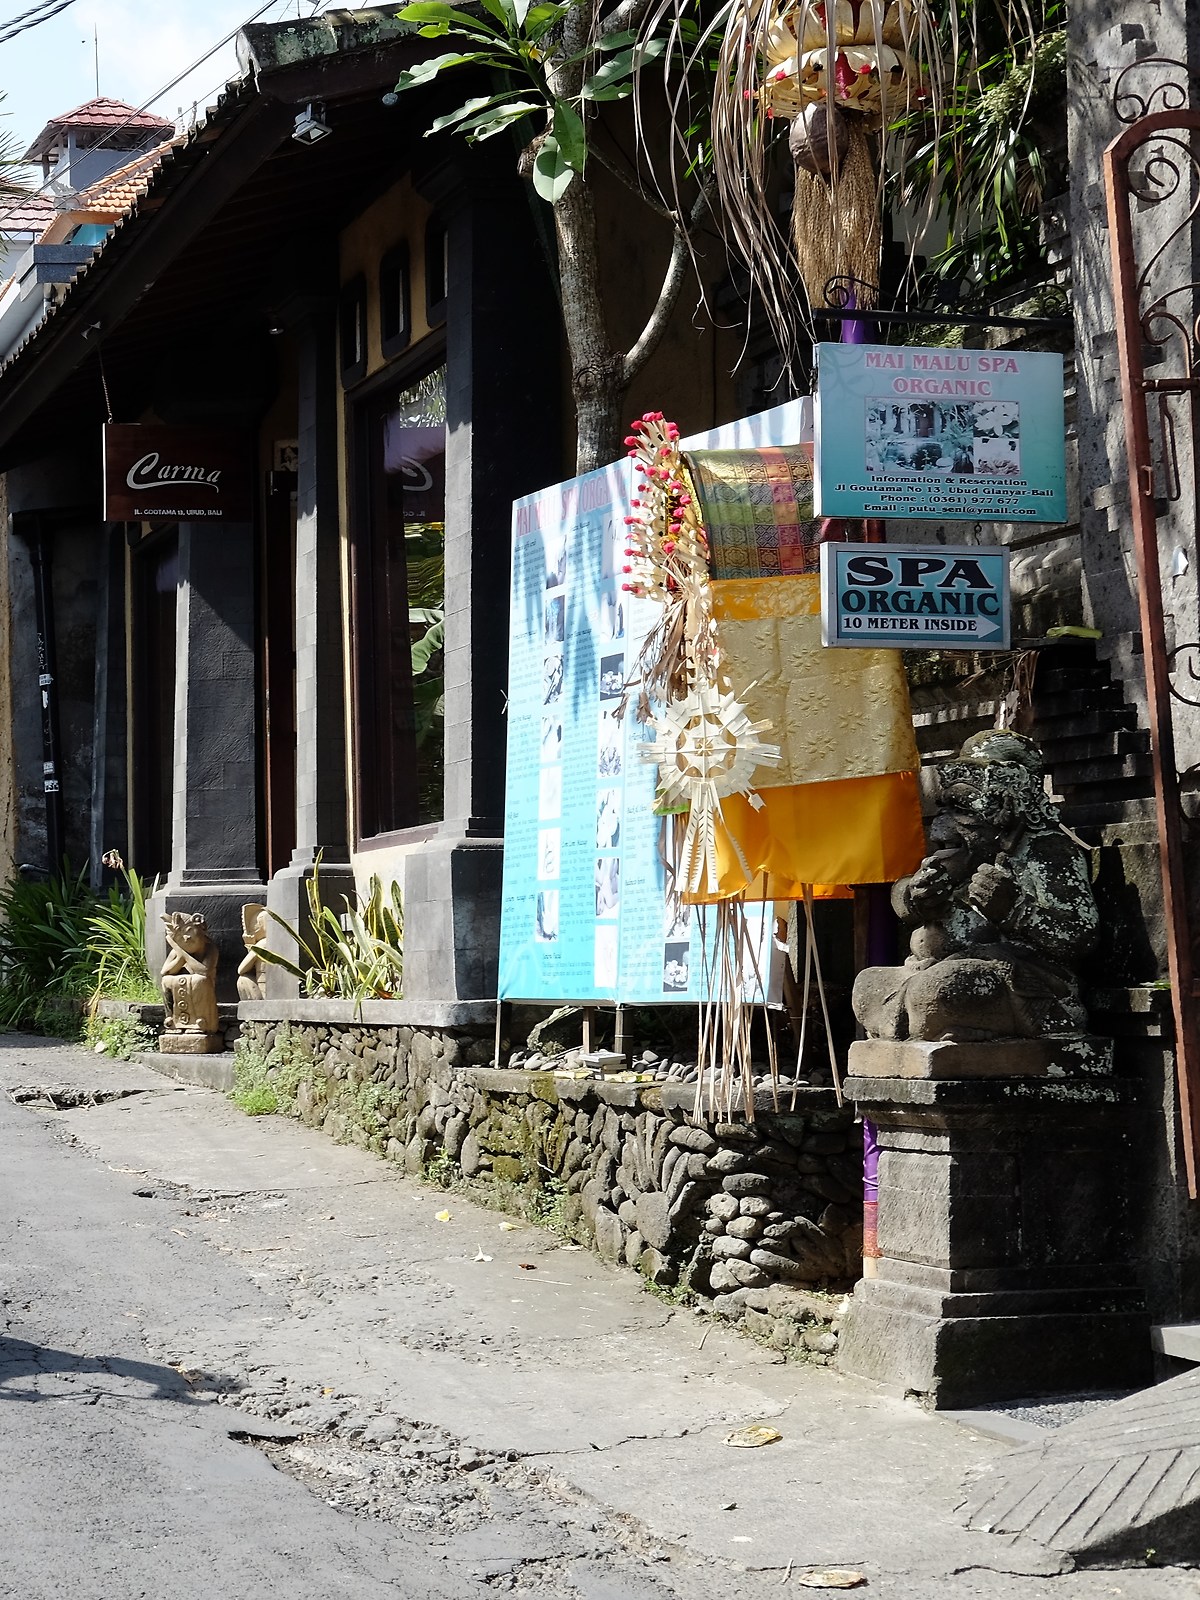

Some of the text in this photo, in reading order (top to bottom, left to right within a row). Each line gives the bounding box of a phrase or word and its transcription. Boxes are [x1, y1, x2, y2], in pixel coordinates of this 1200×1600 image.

[865, 352, 1019, 373] MAI MALU SPA
[892, 377, 992, 397] ORGANIC
[126, 452, 223, 493] Carma
[871, 475, 941, 484] Information
[959, 477, 1027, 486] Reservation
[849, 484, 903, 492] Goutama
[927, 486, 945, 494] 13,
[982, 488, 1054, 496] Gianyar-Bali
[880, 494, 917, 502] Phone
[929, 496, 967, 504] (0361)
[846, 556, 994, 590] SPA
[841, 588, 1001, 617] ORGANIC
[842, 616, 978, 632] 10 METER INSIDE
